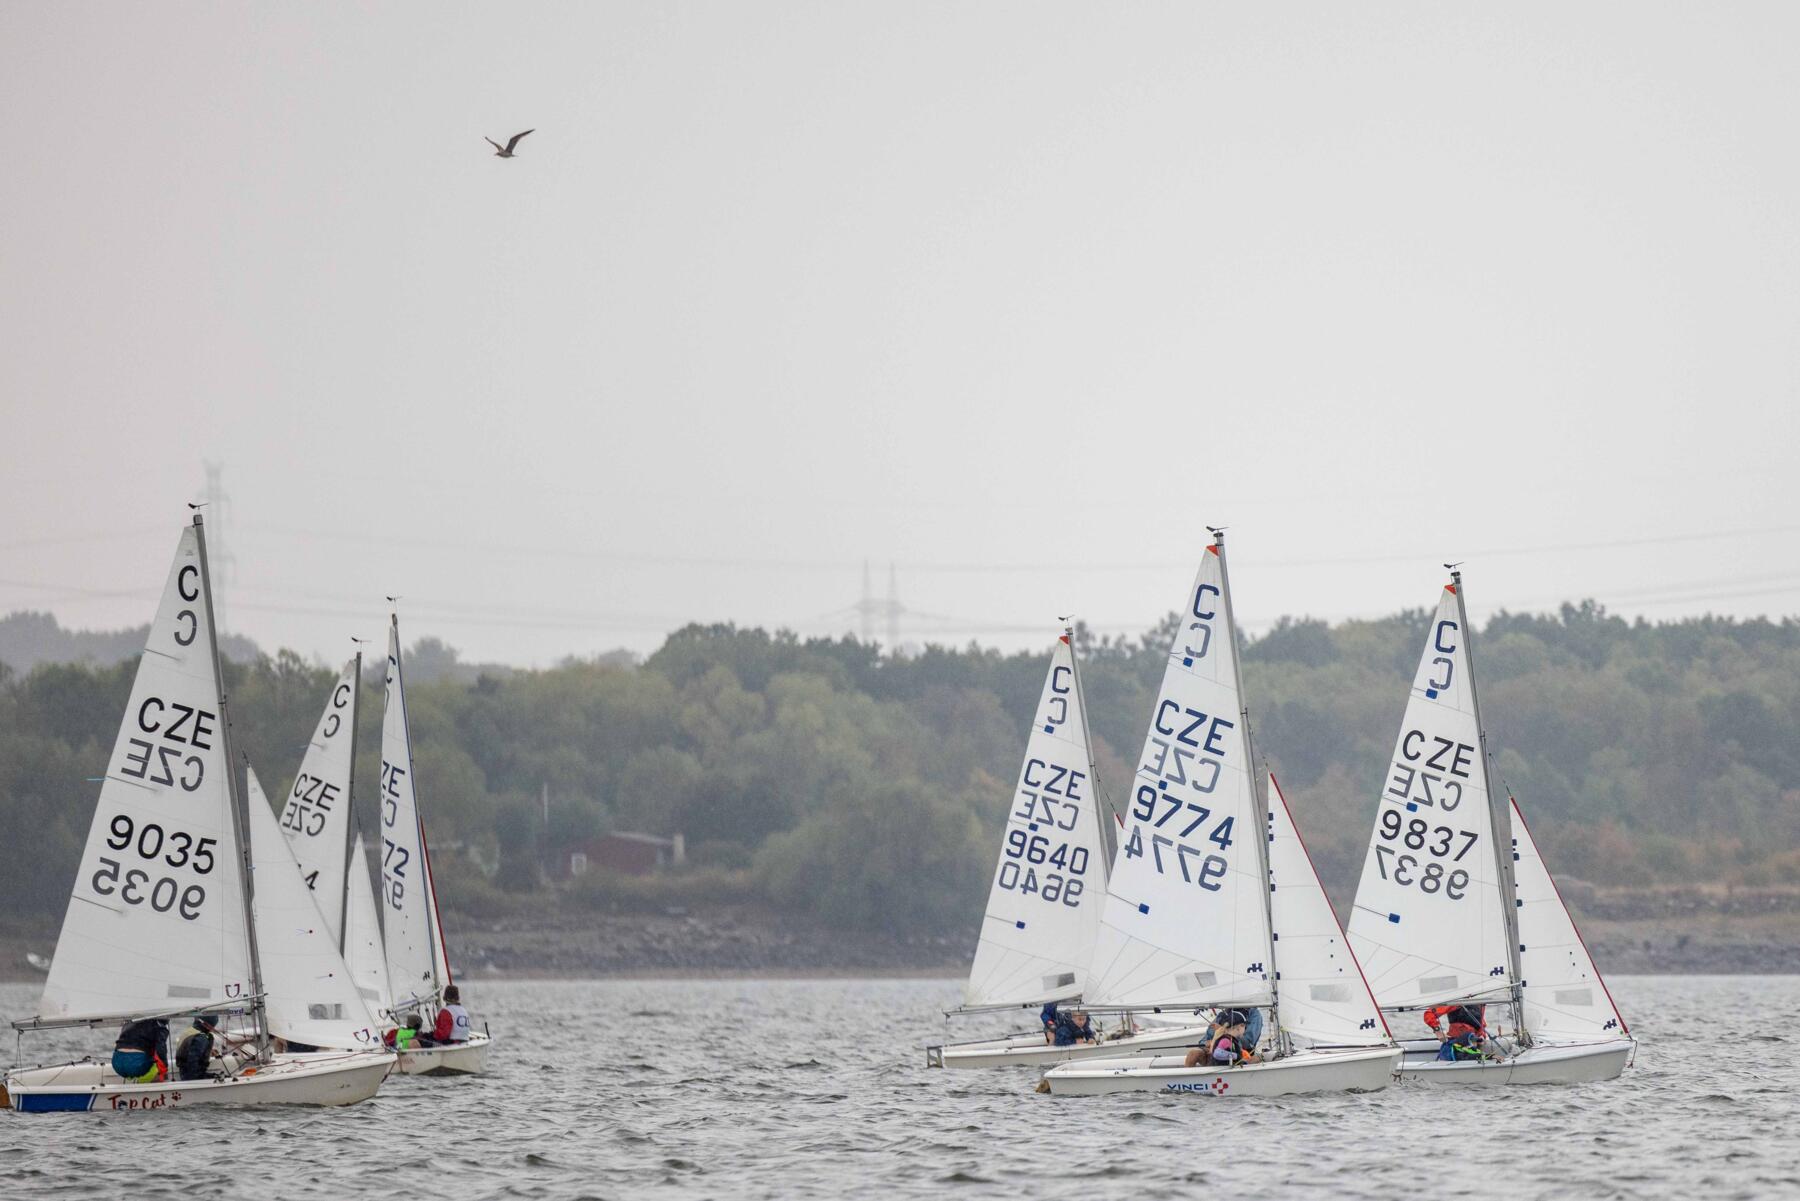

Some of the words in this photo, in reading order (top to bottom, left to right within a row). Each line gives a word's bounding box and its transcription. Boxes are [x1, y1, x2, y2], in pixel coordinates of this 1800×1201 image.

[177, 565, 199, 602] C
[1192, 584, 1220, 620] C
[1435, 620, 1458, 653] C
[333, 685, 350, 709] C
[1051, 666, 1072, 694] C
[138, 697, 216, 751] CZE
[1154, 699, 1234, 757] CZE
[1402, 729, 1475, 778] CZE
[294, 773, 341, 811] CZE
[1022, 758, 1085, 800] CZE
[1133, 785, 1235, 851] 9774
[1379, 809, 1479, 862] 9837
[107, 815, 217, 874] 9035
[1006, 829, 1089, 876] 9640
[1167, 1083, 1208, 1091] VINCI
